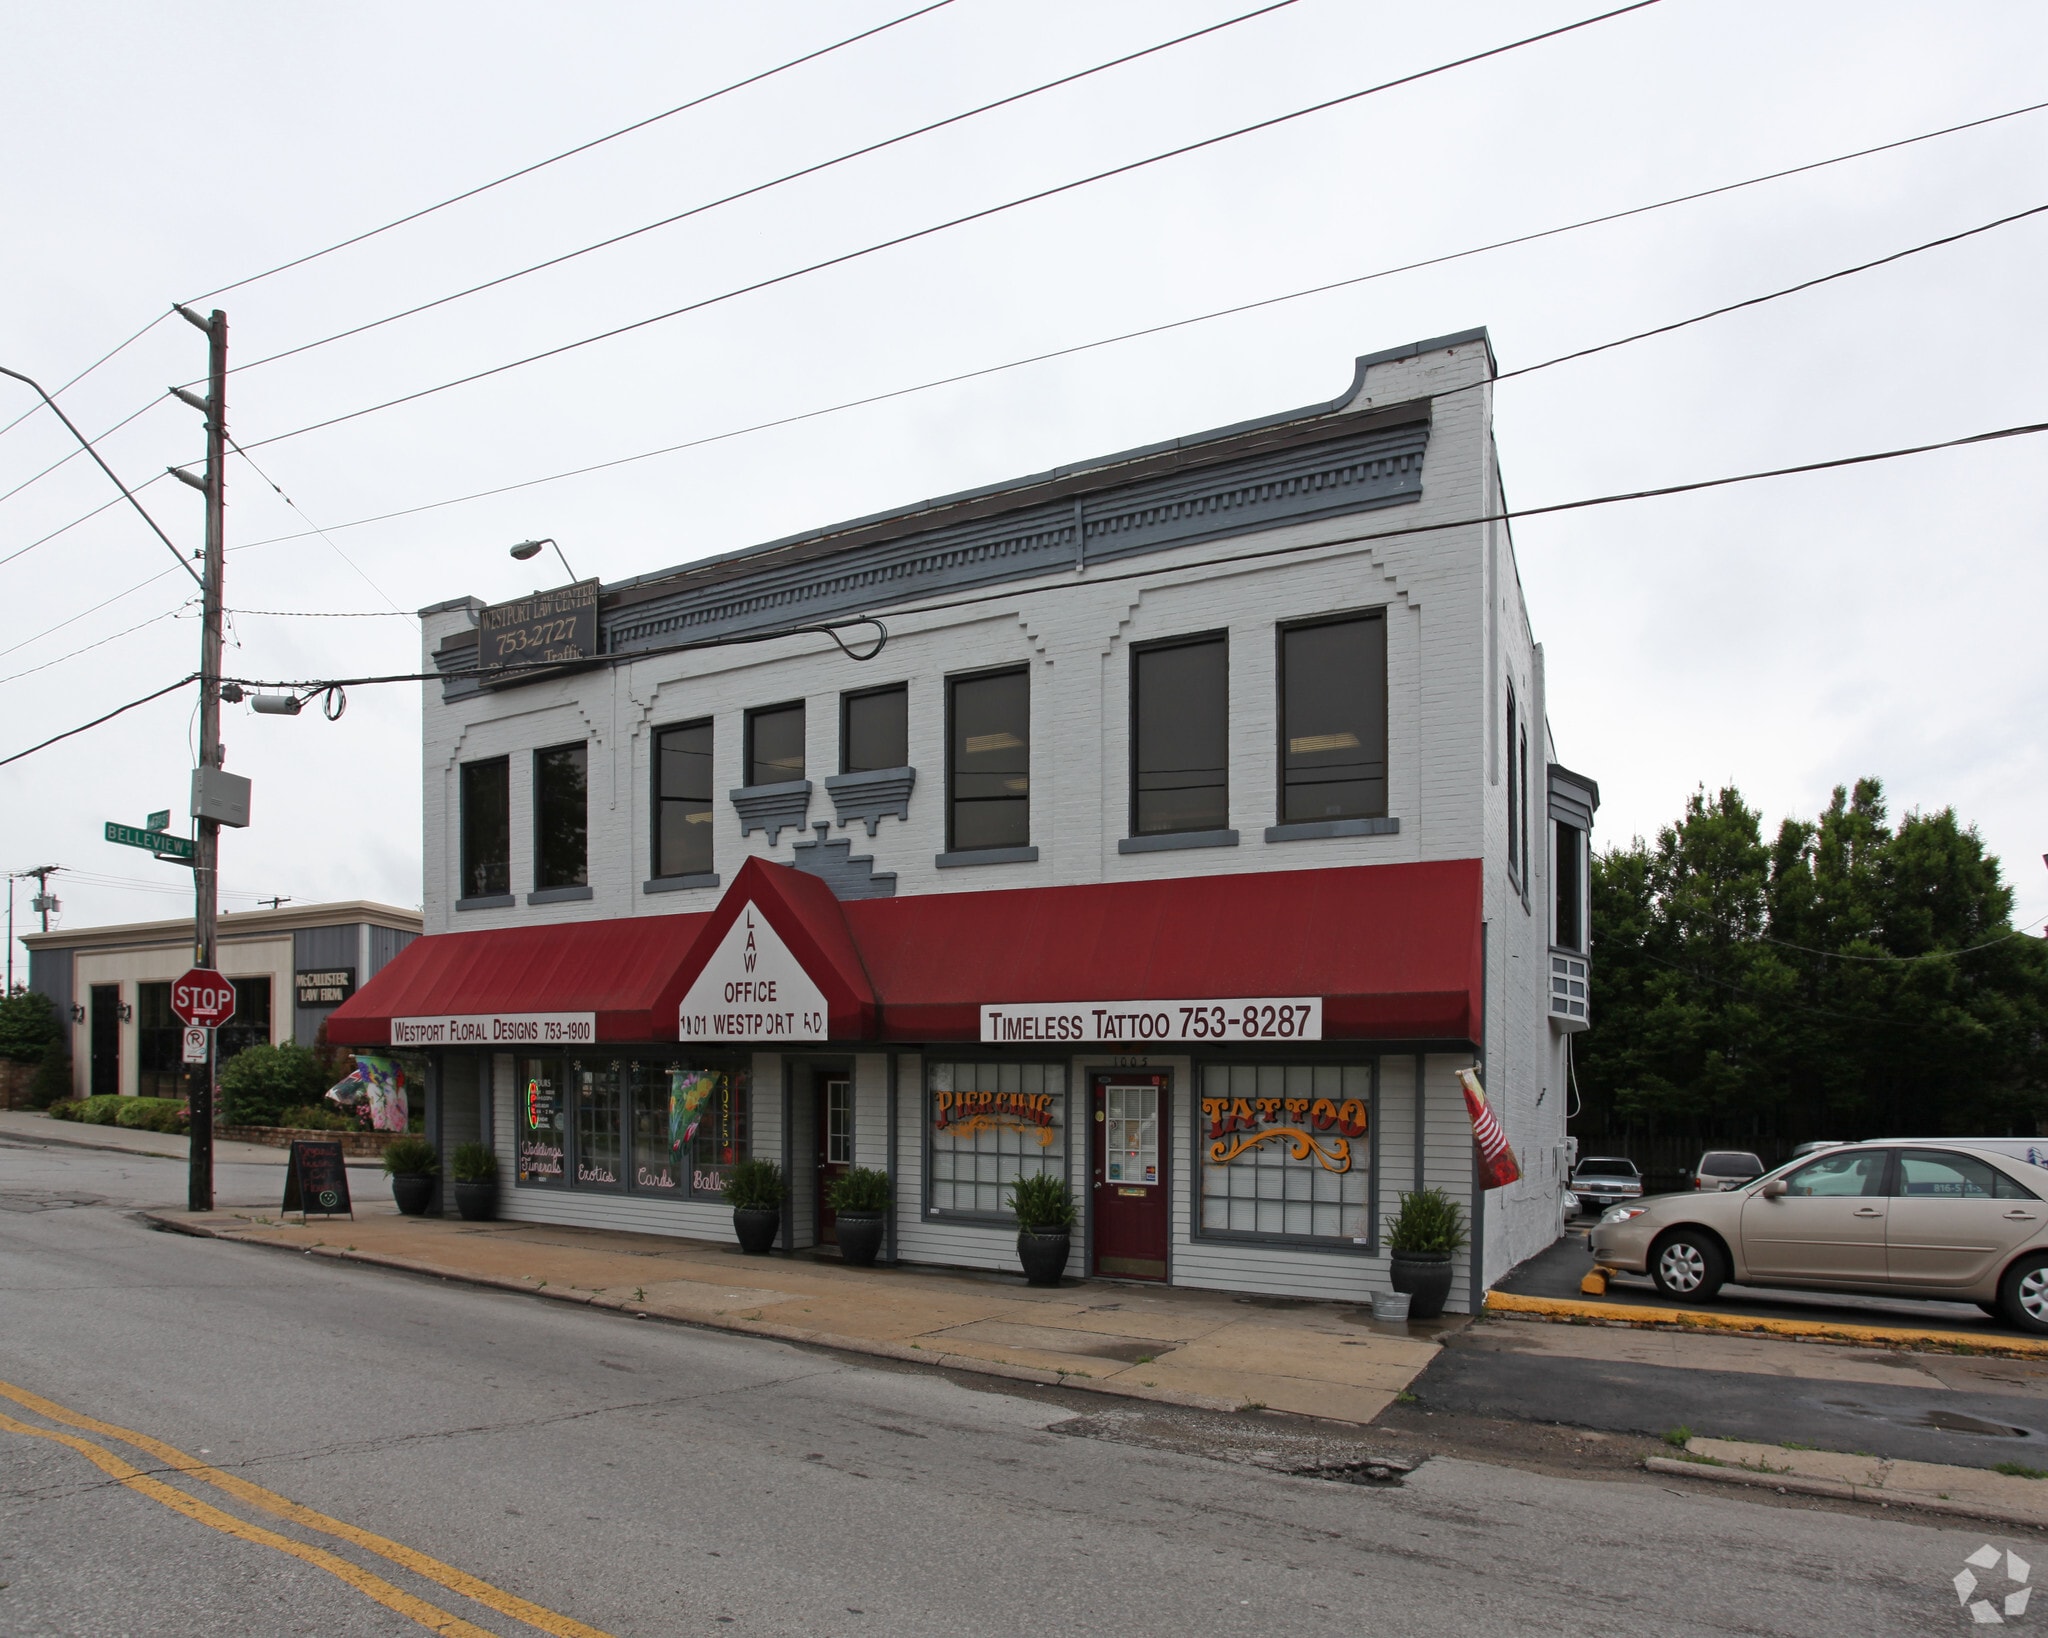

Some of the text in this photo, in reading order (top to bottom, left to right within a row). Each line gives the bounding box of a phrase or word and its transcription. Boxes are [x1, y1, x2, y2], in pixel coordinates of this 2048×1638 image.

[482, 583, 595, 630] WESTPORT LAW CENTER
[496, 616, 577, 656] 753-2727
[543, 643, 584, 661] Traffic
[107, 825, 184, 853] BELLEVIEW
[176, 985, 231, 1010] STOP
[301, 987, 344, 1001] LAW FIRM
[724, 981, 777, 1003] OFFICE
[544, 1021, 591, 1040] 753-1900
[713, 1013, 795, 1035] WESTPORT
[1178, 1005, 1312, 1038] 753-8287
[1114, 1057, 1148, 1068] 1005
[935, 1090, 1055, 1130] PIERCING
[1201, 1097, 1368, 1139] TATTOO
[521, 1141, 564, 1160] Weddings
[521, 1157, 562, 1174] Funerals
[578, 1163, 617, 1183] Exotics
[637, 1166, 676, 1188] Cards
